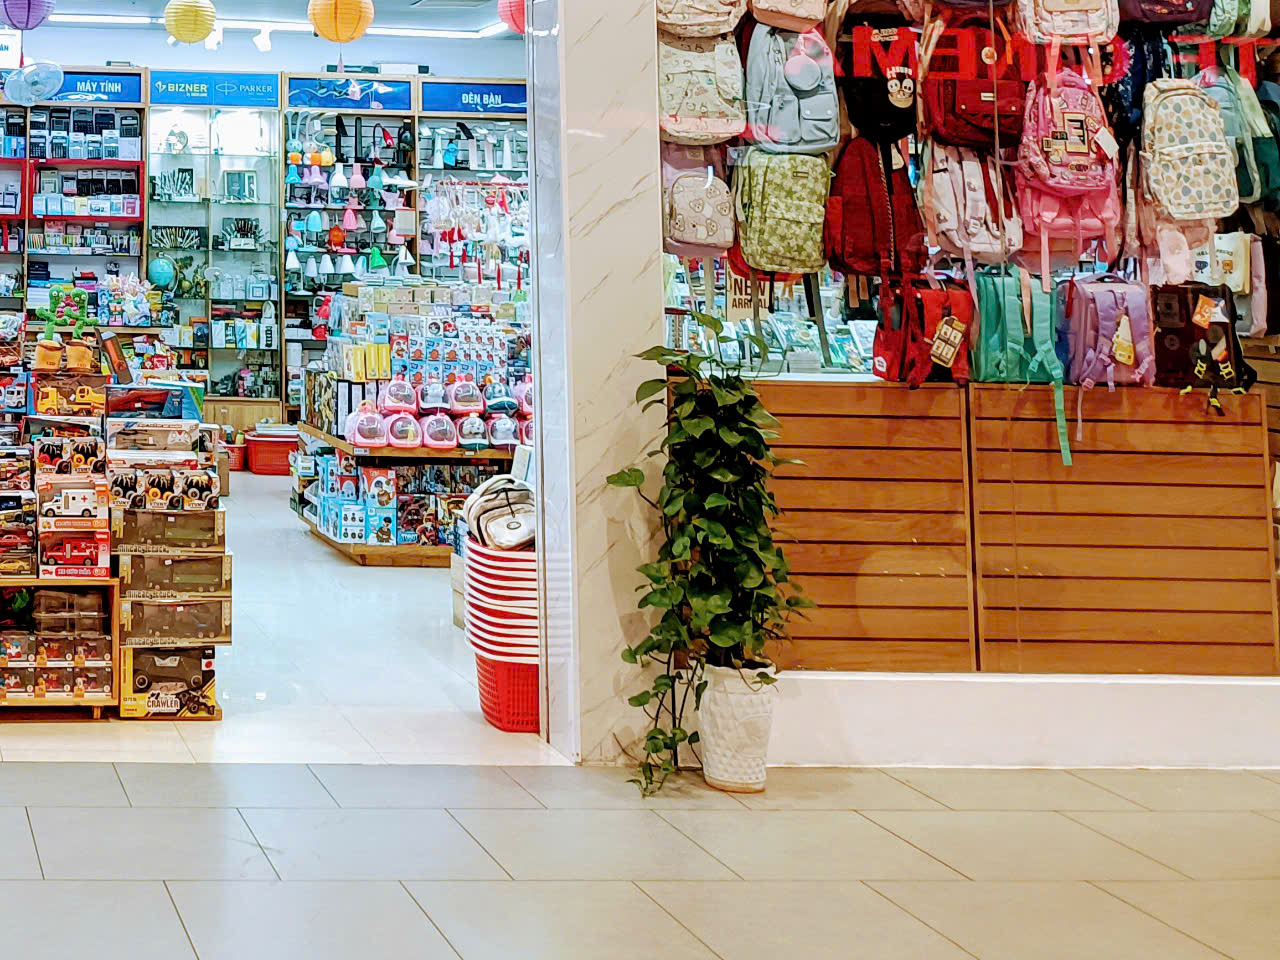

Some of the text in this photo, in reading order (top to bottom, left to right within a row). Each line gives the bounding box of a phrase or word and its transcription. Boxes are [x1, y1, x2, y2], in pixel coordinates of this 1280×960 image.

[77, 80, 121, 93] MÁY TÍNH
[167, 83, 208, 93] BIZNER
[239, 84, 273, 93] PARKER
[462, 91, 502, 105] ĐÈN BÀN
